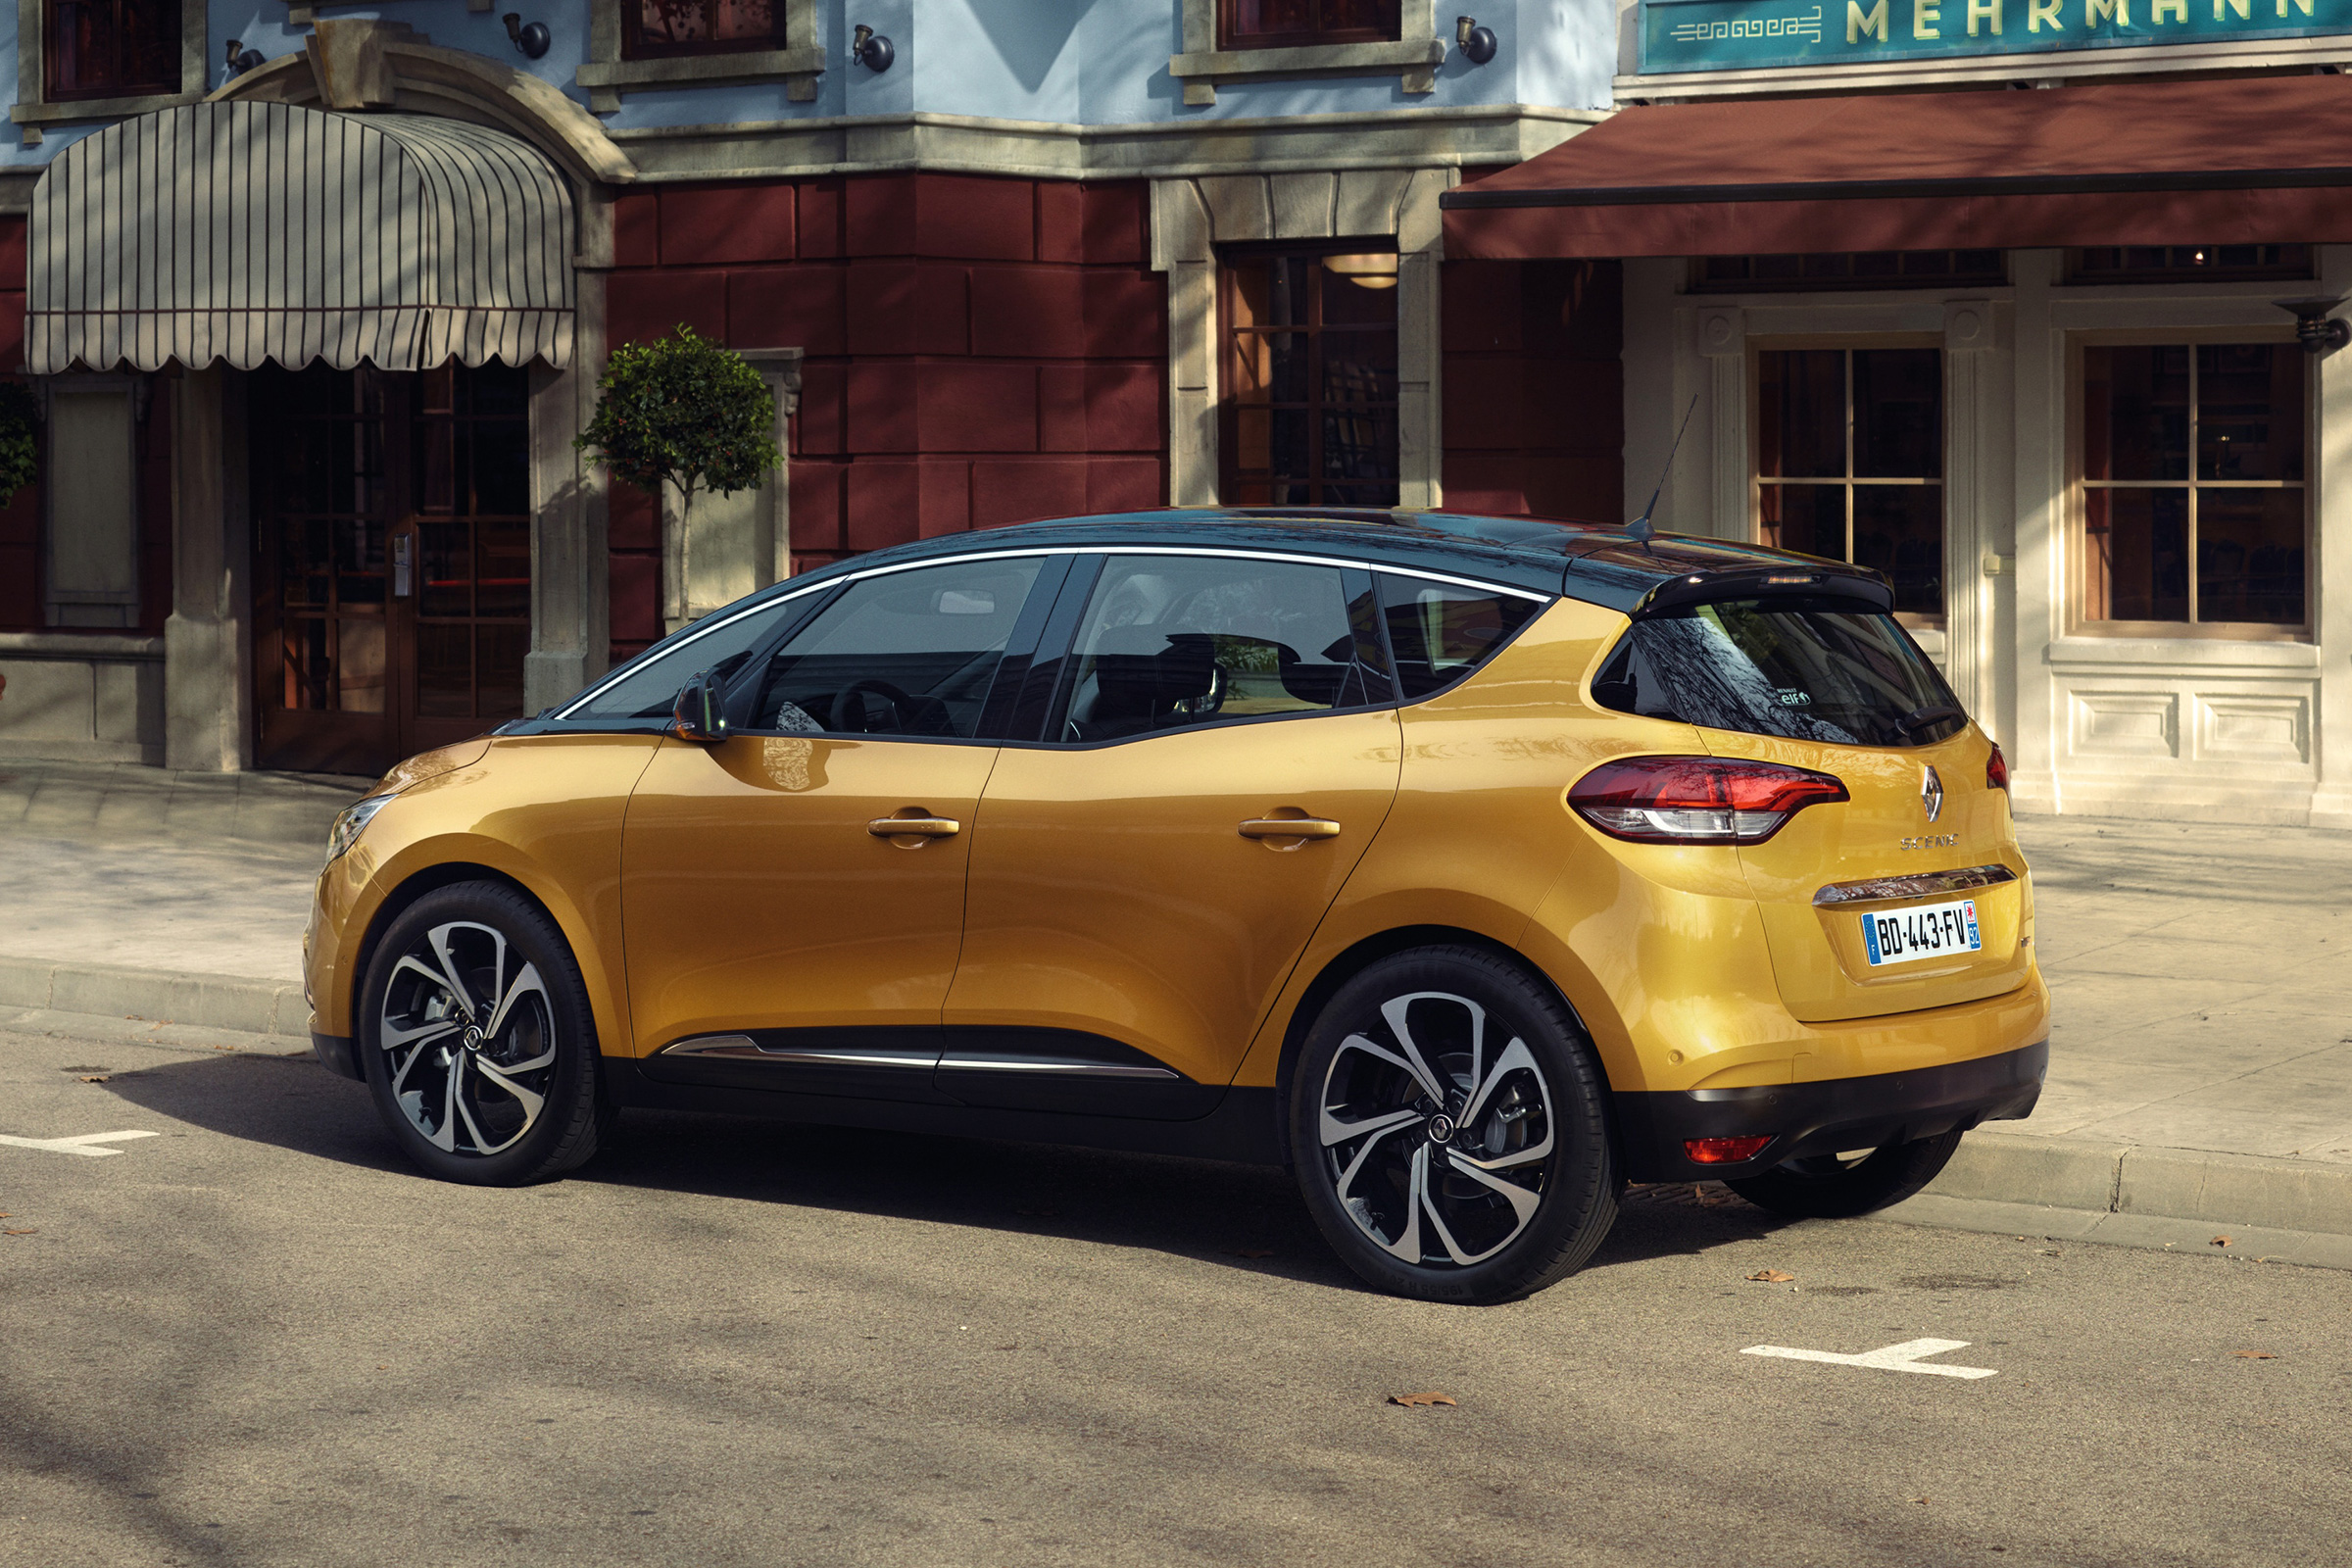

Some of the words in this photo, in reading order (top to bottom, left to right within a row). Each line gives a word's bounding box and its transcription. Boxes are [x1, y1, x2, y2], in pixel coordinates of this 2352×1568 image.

[1781, 693, 1799, 705] elf
[1900, 833, 1959, 851] SCENIC
[1877, 908, 1966, 956] BD-443-FV
[1969, 926, 1980, 945] 92
